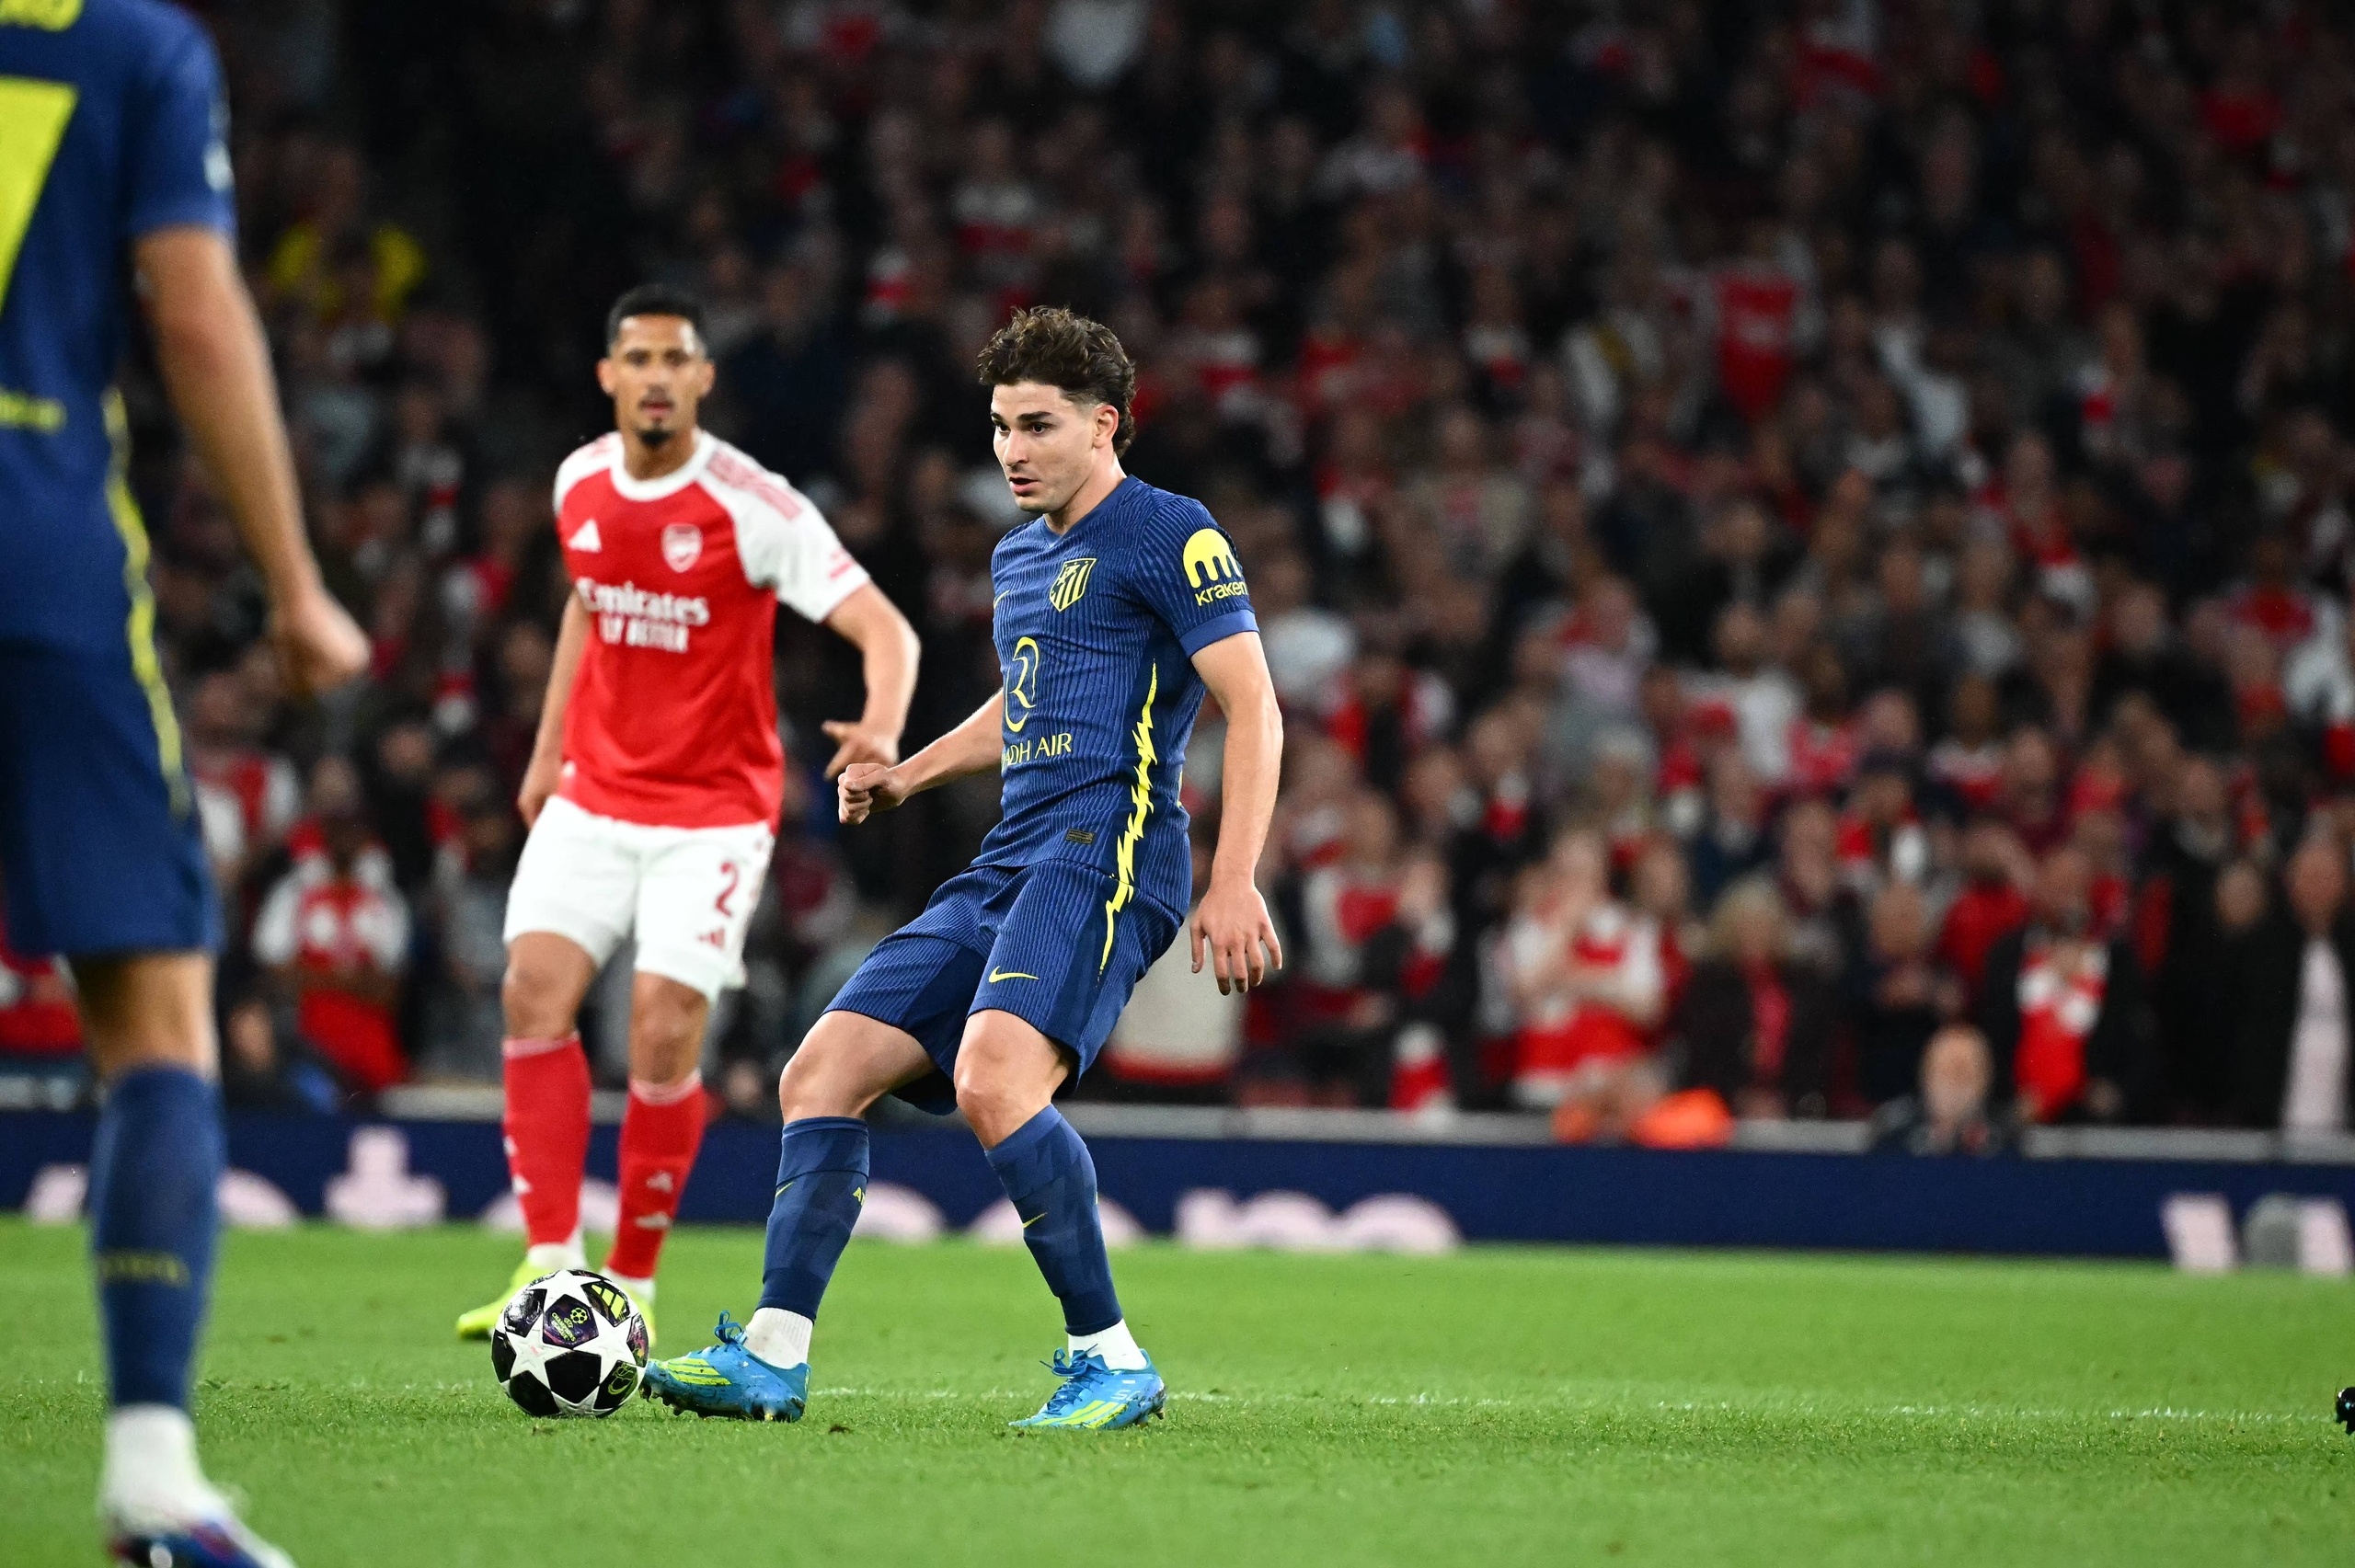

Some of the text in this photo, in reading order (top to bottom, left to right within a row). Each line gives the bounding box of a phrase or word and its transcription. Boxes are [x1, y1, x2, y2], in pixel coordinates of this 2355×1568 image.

[576, 576, 711, 627] Emirates
[1034, 732, 1072, 759] AIR
[714, 861, 740, 918] 2
